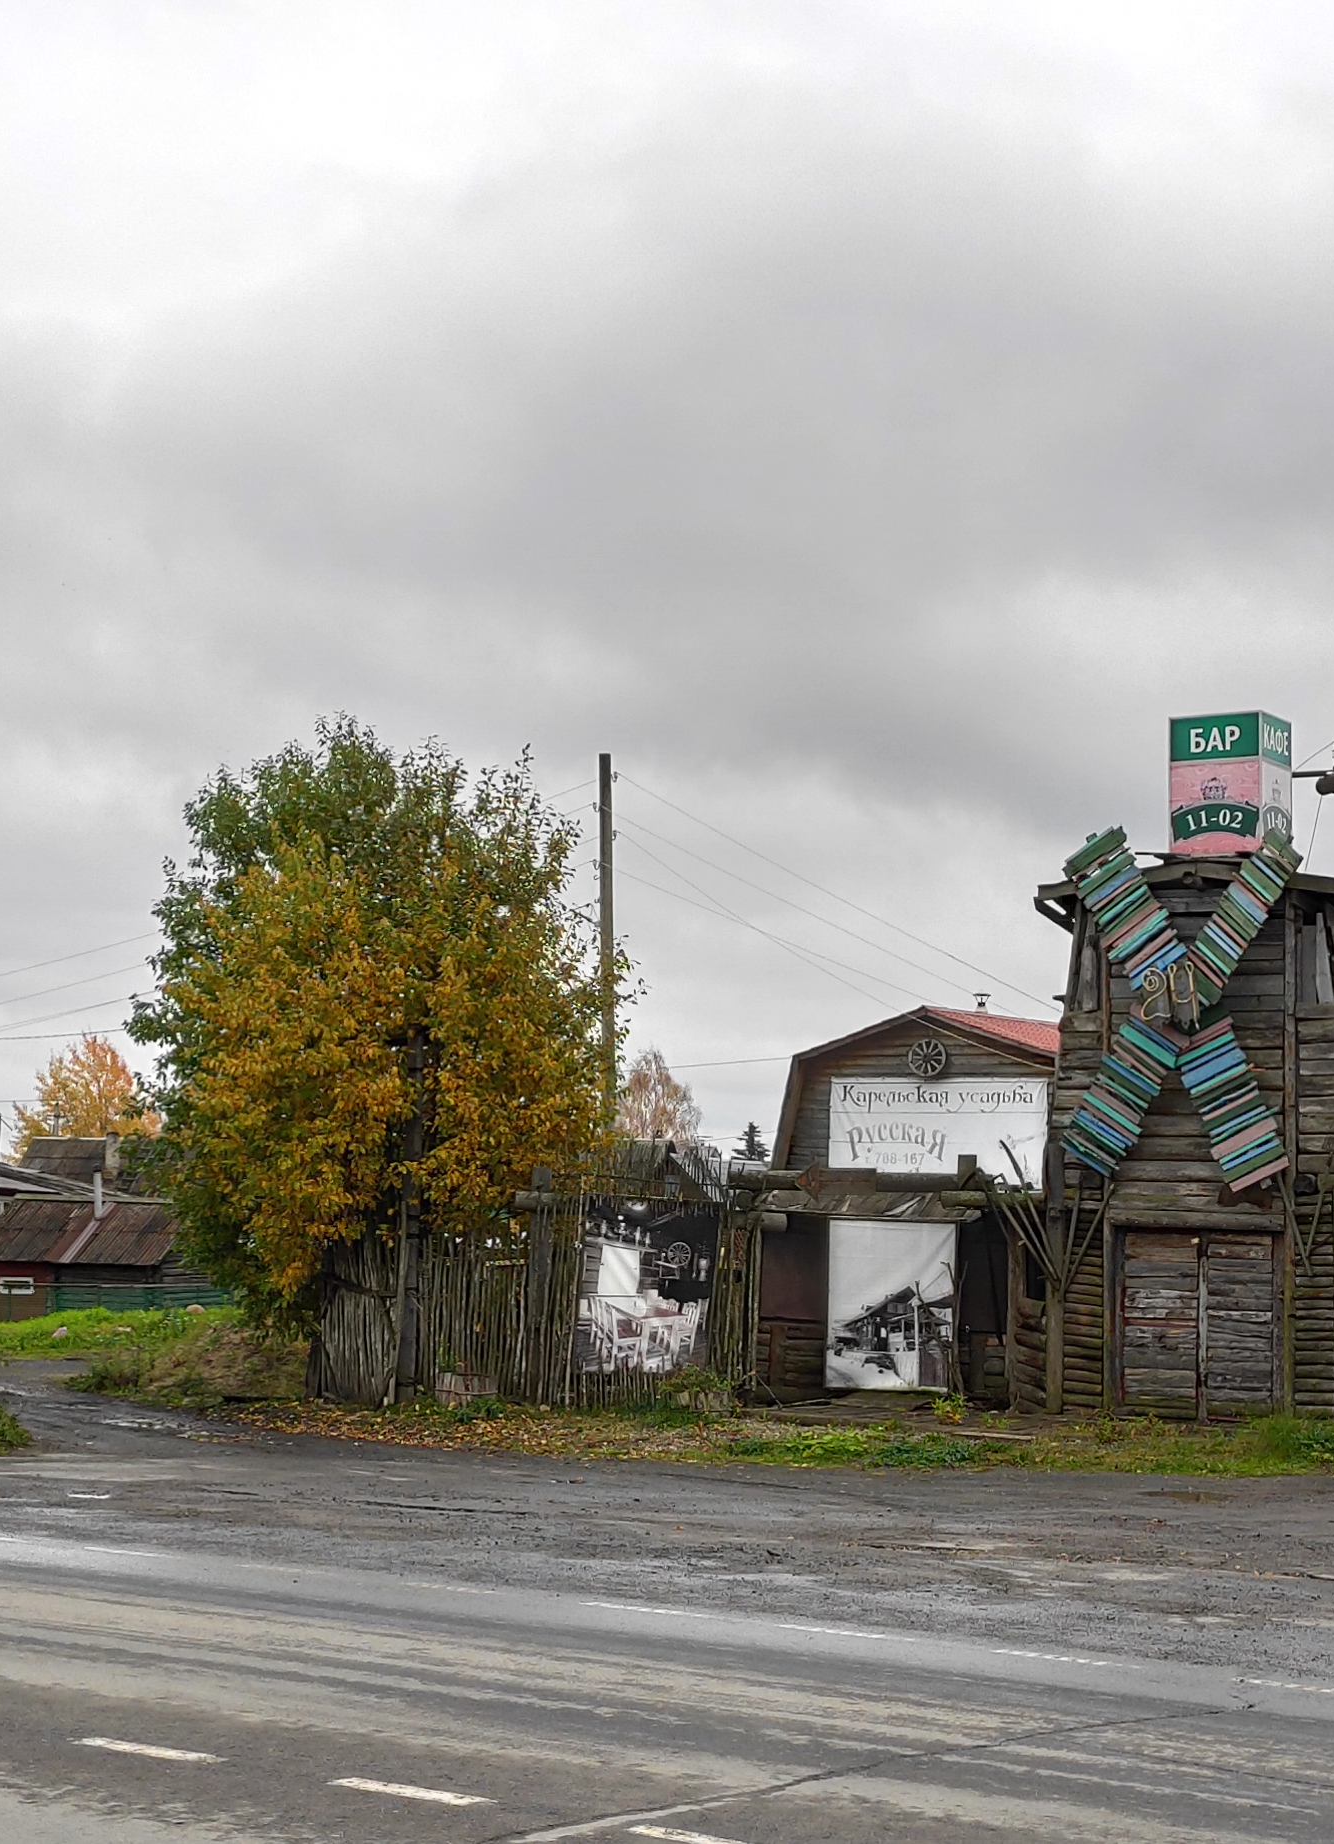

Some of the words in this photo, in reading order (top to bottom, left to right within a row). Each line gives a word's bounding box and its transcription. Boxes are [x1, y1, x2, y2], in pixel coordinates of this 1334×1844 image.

[1190, 725, 1241, 753] БАР
[1263, 723, 1289, 756] КАФЕ
[1185, 808, 1244, 831] 11-02
[842, 1085, 949, 1113] Карельская
[946, 1085, 1034, 1113] усадьба
